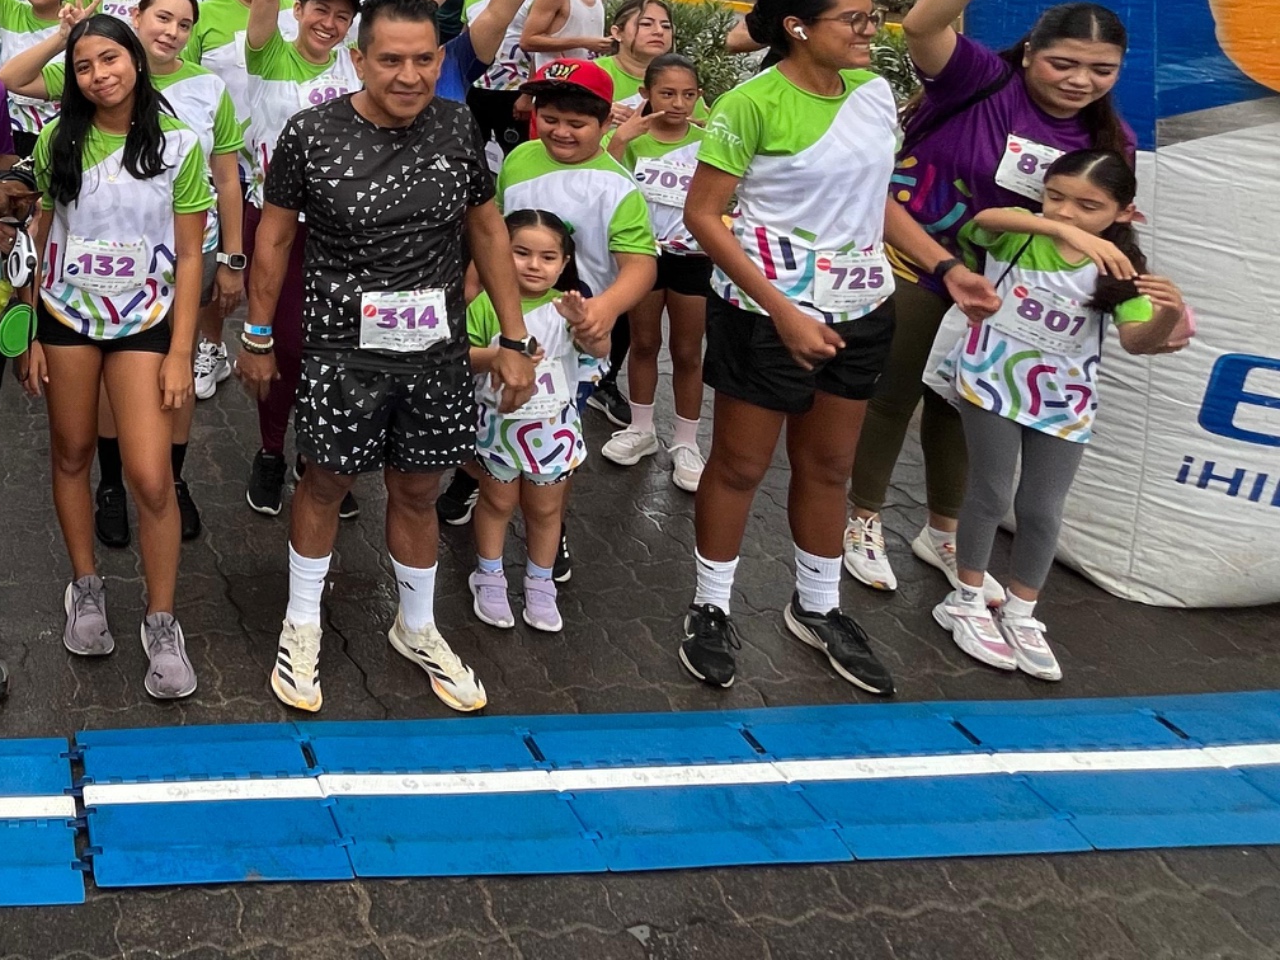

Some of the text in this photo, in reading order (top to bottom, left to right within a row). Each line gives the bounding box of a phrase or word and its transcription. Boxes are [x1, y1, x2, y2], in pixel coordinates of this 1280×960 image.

[77, 253, 136, 277] 132
[829, 266, 885, 290] 725
[376, 305, 440, 330] 314
